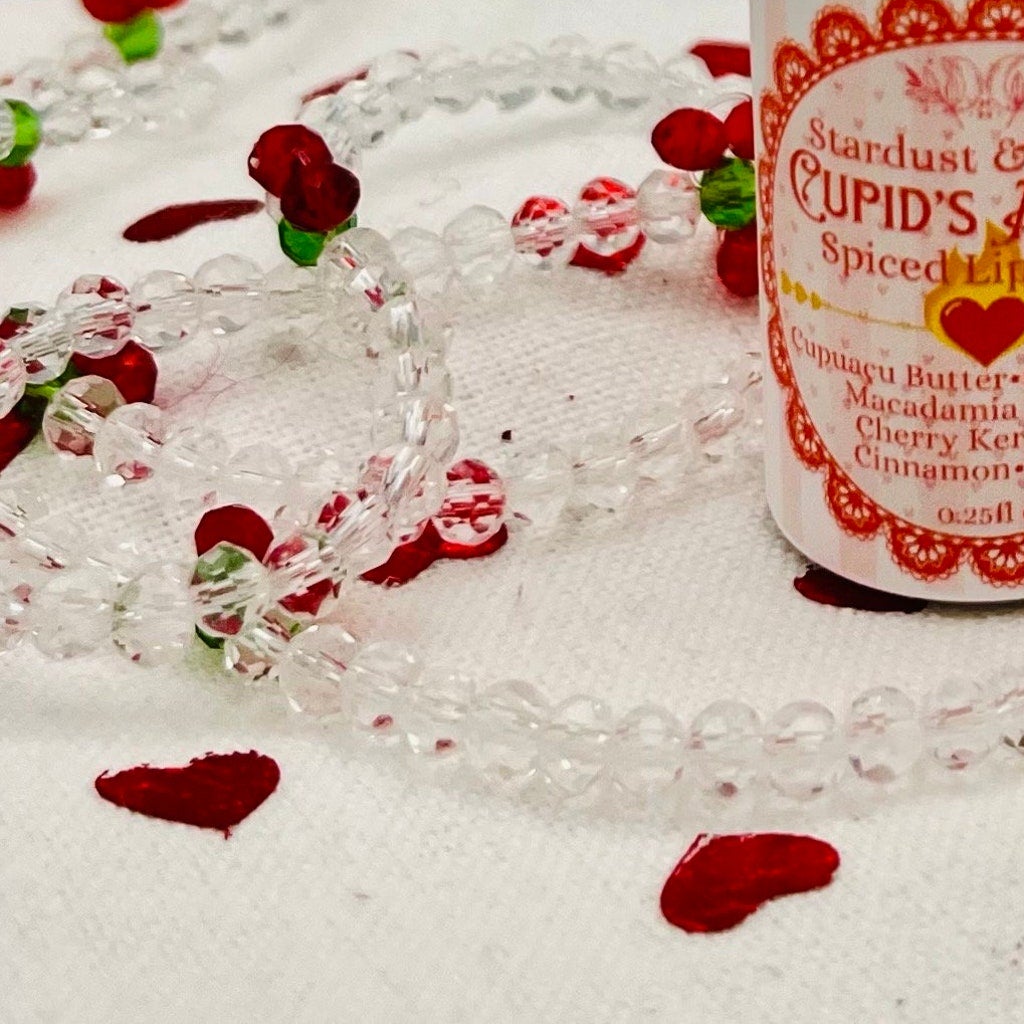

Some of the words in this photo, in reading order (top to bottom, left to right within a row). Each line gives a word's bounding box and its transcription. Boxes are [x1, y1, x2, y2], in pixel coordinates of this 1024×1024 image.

[809, 116, 976, 174] Stardust
[789, 148, 977, 236] CUPID'S
[821, 231, 947, 284] Spiced
[846, 380, 1018, 422] Macadamia
[855, 414, 957, 456] Cherry
